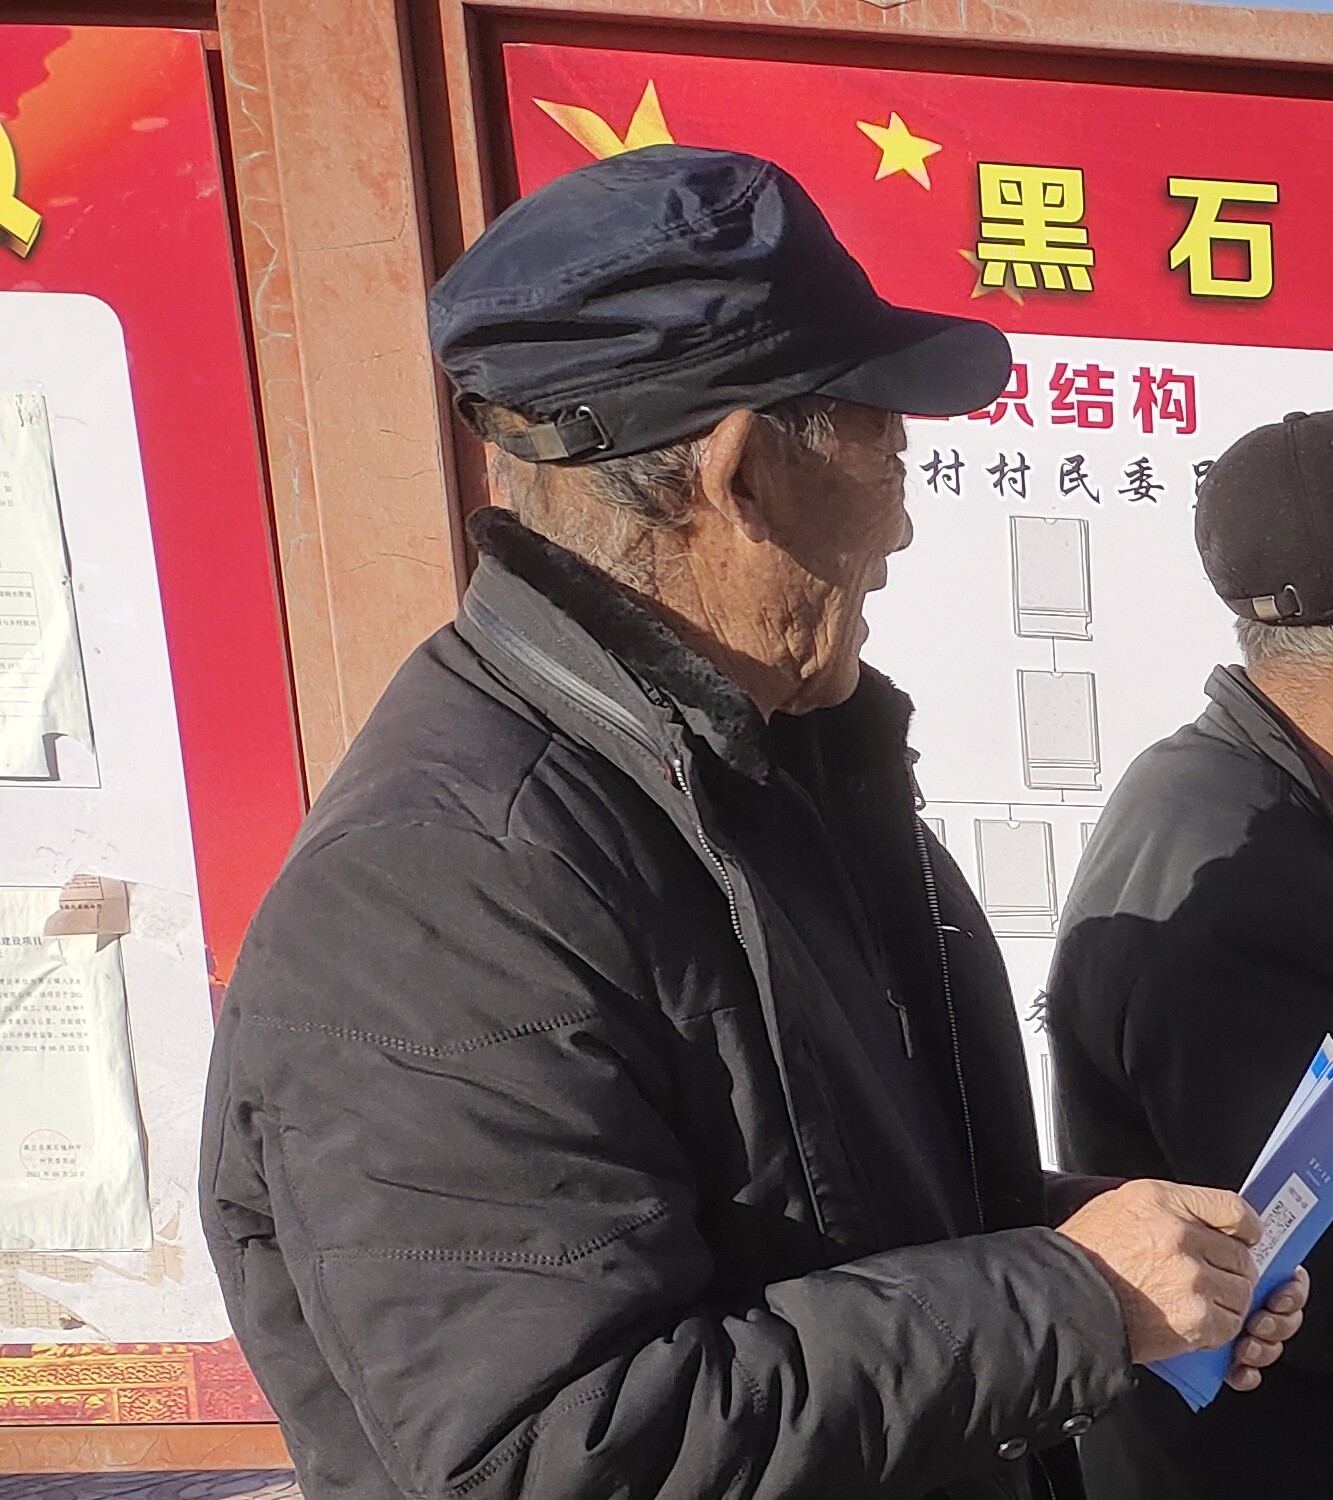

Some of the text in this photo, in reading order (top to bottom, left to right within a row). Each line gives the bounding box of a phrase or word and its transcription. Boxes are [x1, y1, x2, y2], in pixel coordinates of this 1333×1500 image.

[904, 361, 1197, 435] 织结构
[919, 447, 1217, 507] 村村民委
